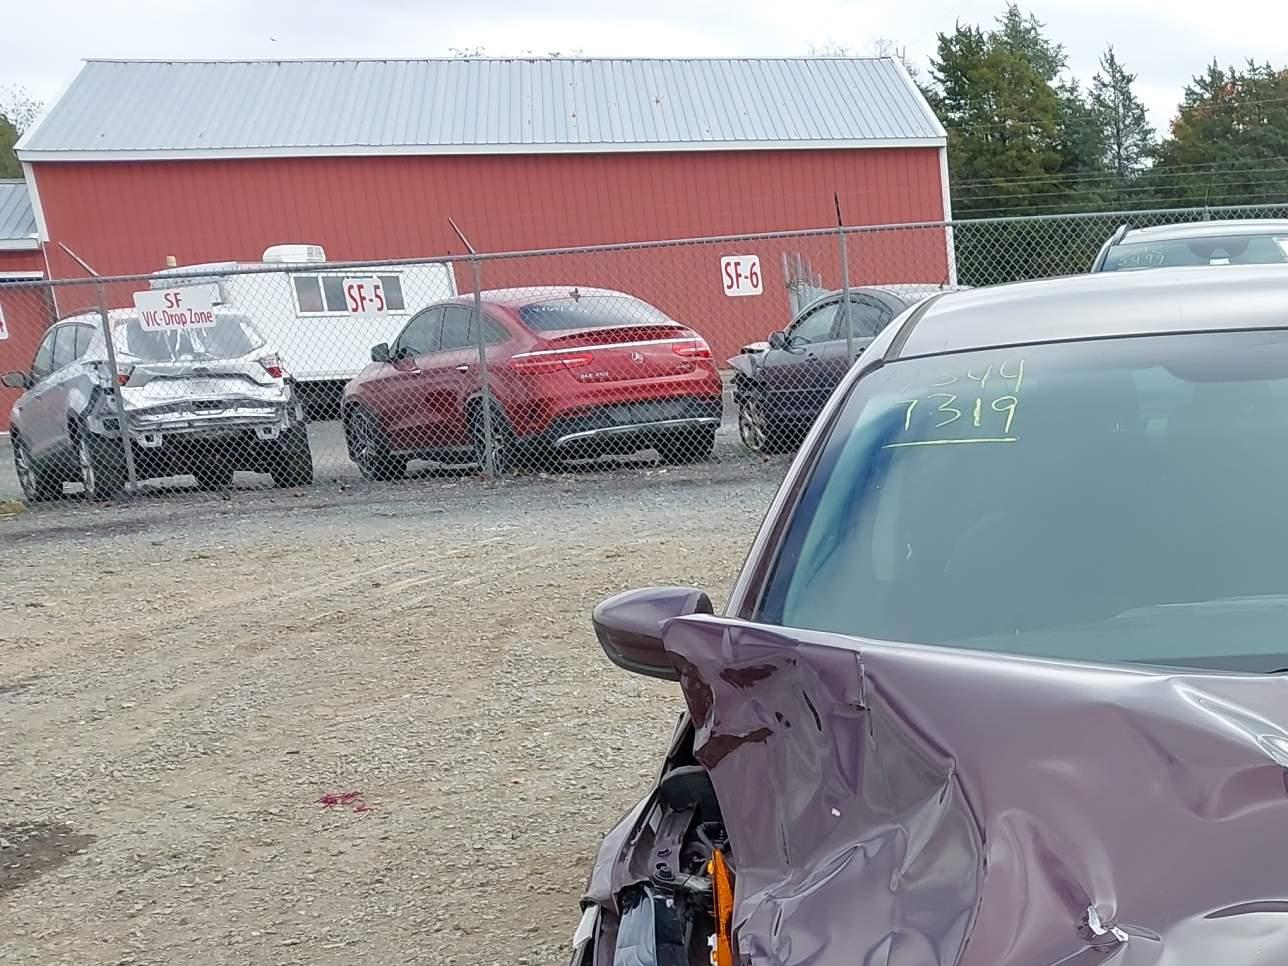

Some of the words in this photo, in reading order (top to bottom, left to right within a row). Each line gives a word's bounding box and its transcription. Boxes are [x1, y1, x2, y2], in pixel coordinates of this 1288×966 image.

[724, 261, 759, 289] SF-6
[164, 292, 182, 309] SF
[347, 284, 384, 312] SF-5
[142, 309, 187, 327] VIC-Drop
[187, 308, 213, 324] Zone
[895, 393, 1019, 433] 7319
